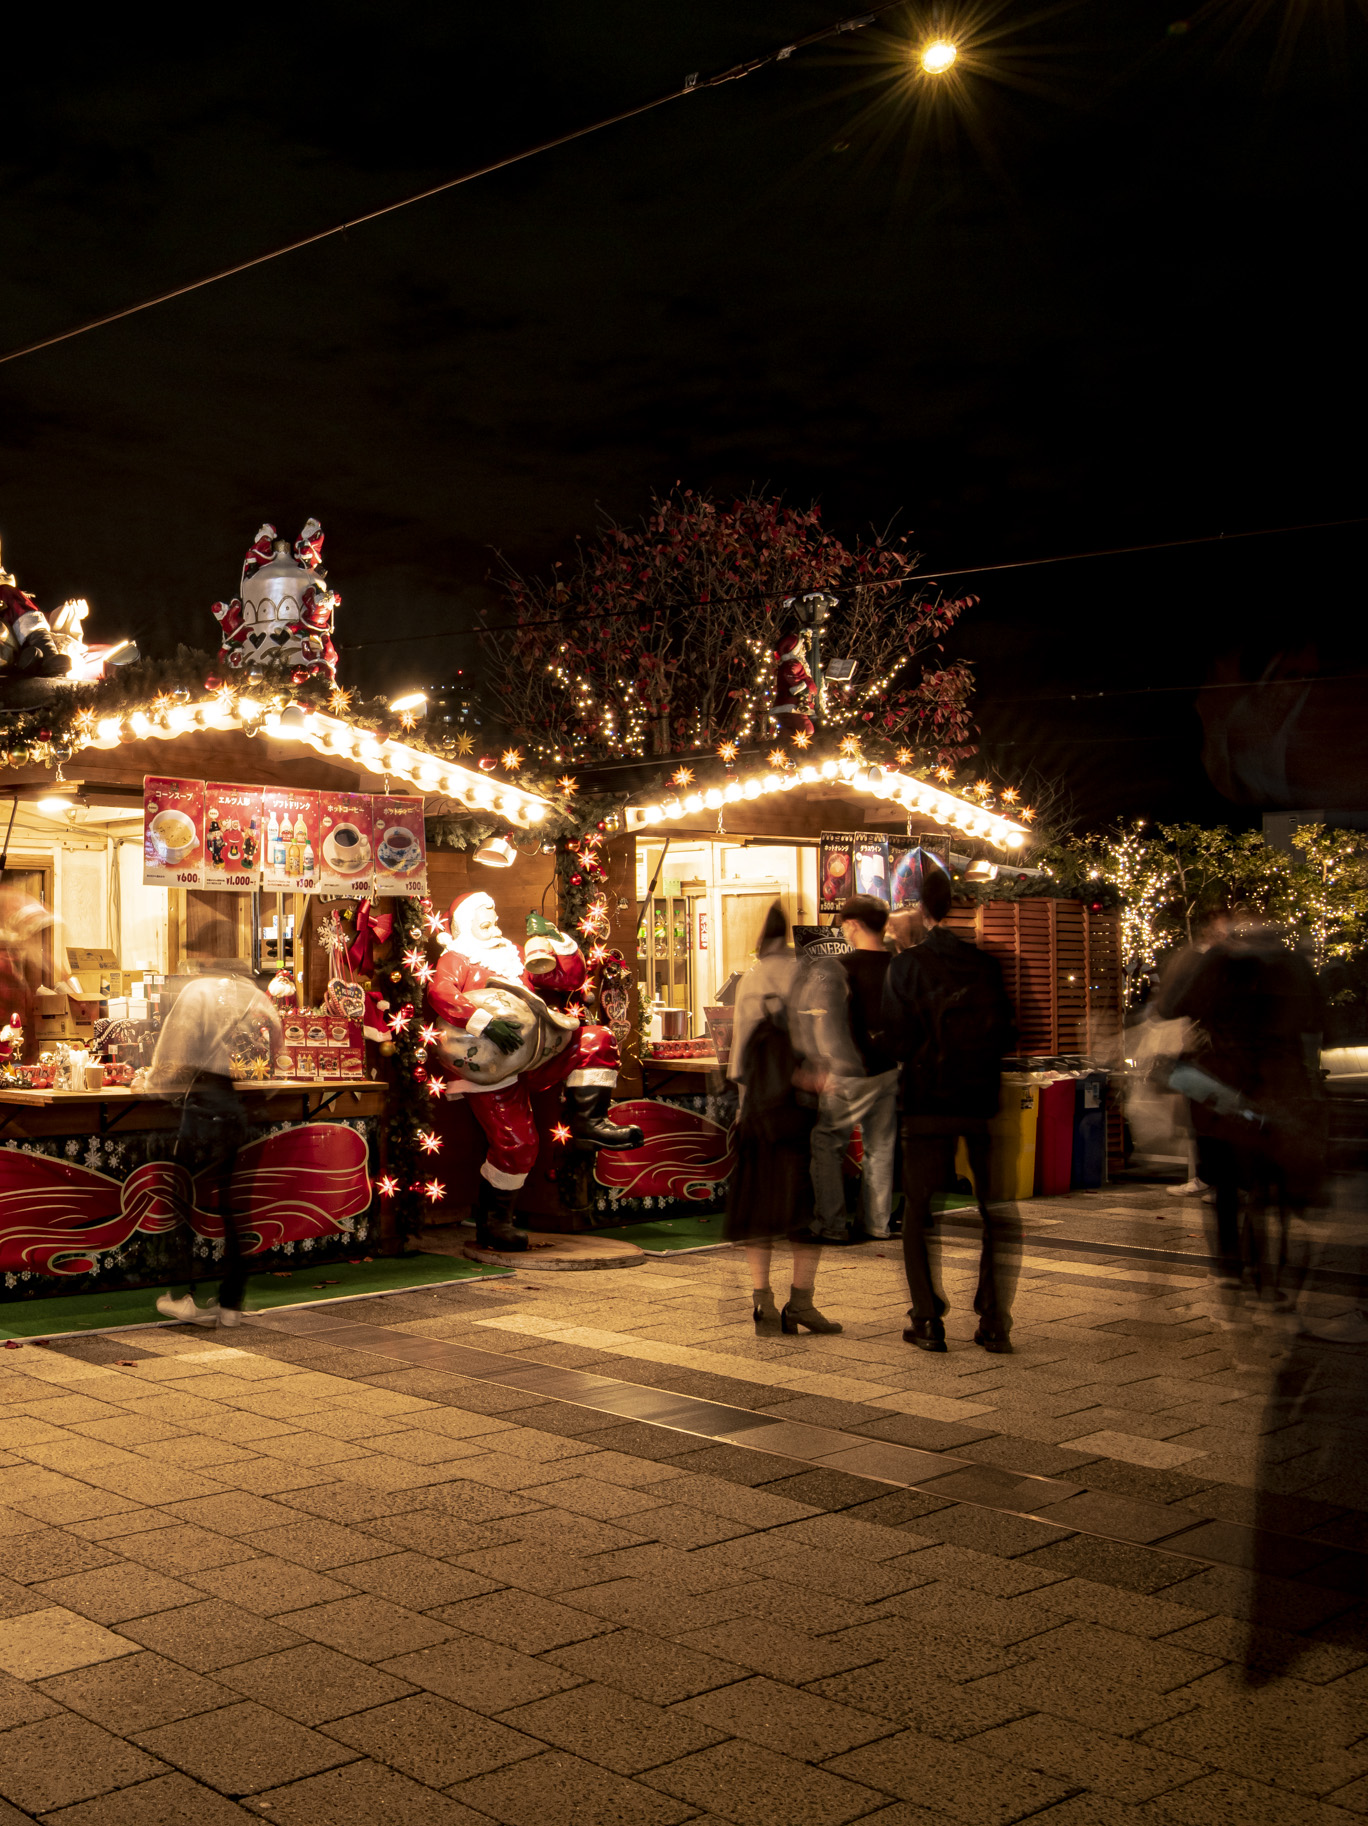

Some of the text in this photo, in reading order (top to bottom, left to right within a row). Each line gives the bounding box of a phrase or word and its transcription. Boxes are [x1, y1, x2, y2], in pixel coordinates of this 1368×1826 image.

[155, 790, 194, 801] コーンスープ
[273, 800, 311, 810] ソフトドリンク
[327, 804, 365, 814] ホットコーヒー
